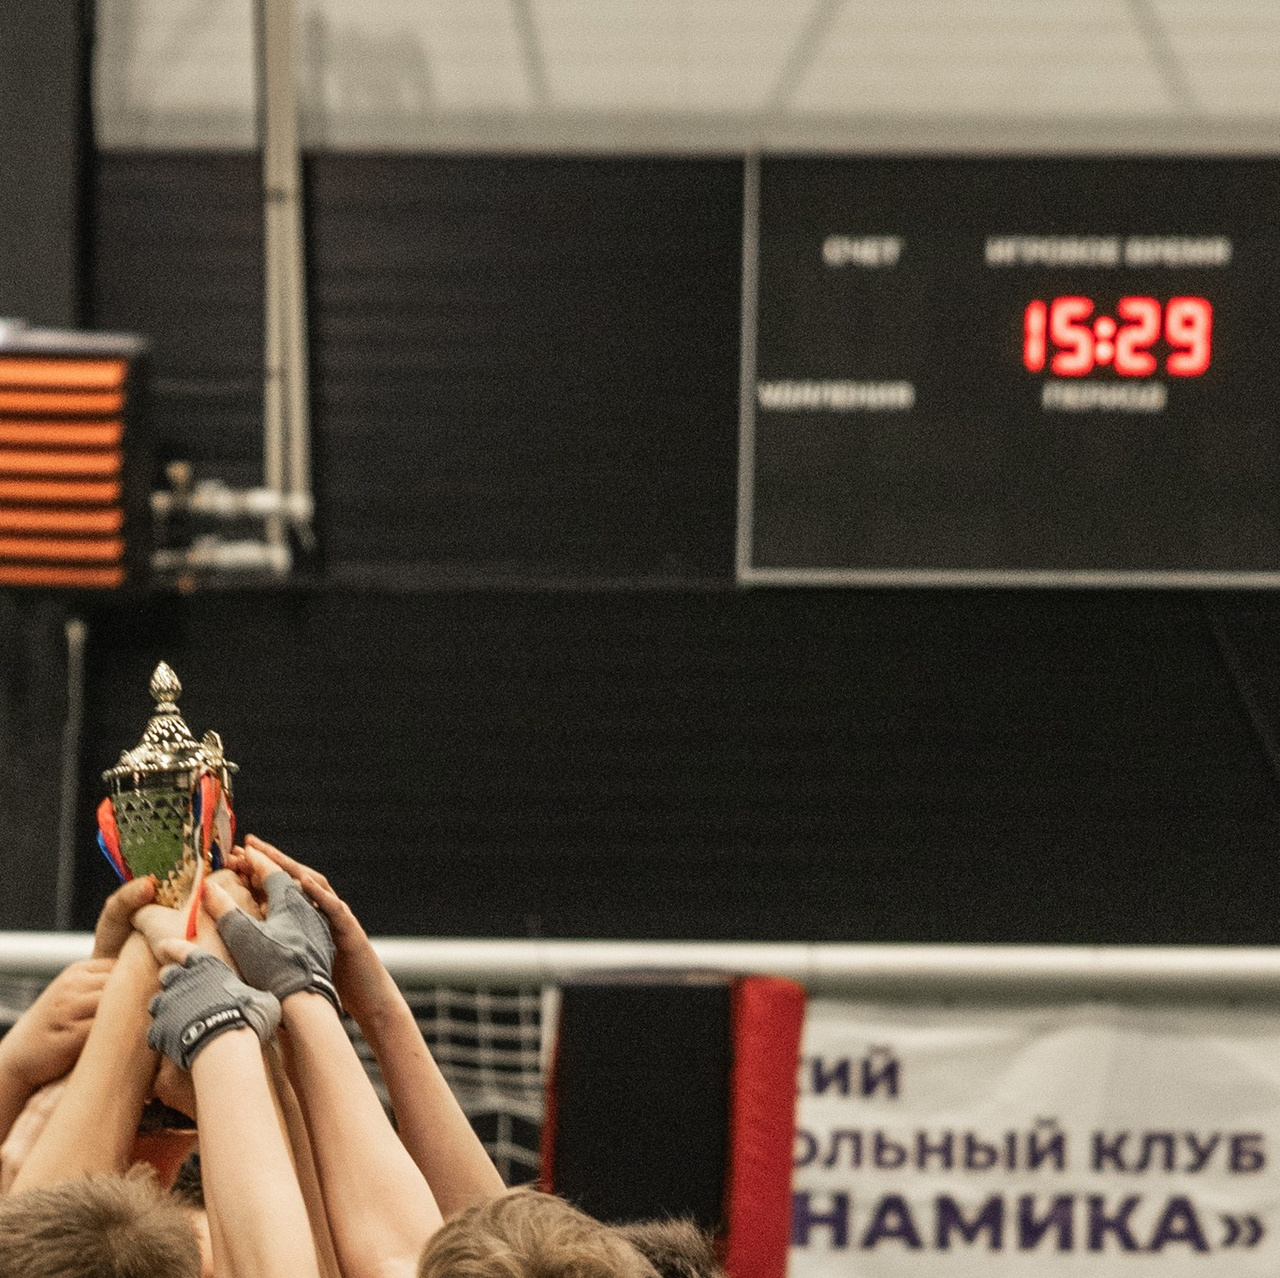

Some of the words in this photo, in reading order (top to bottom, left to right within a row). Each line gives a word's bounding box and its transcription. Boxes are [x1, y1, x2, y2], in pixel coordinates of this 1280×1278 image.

[1023, 296, 1213, 377] 15:29
[799, 1045, 901, 1099] ИЙ
[1091, 1129, 1267, 1174] КЛУБ
